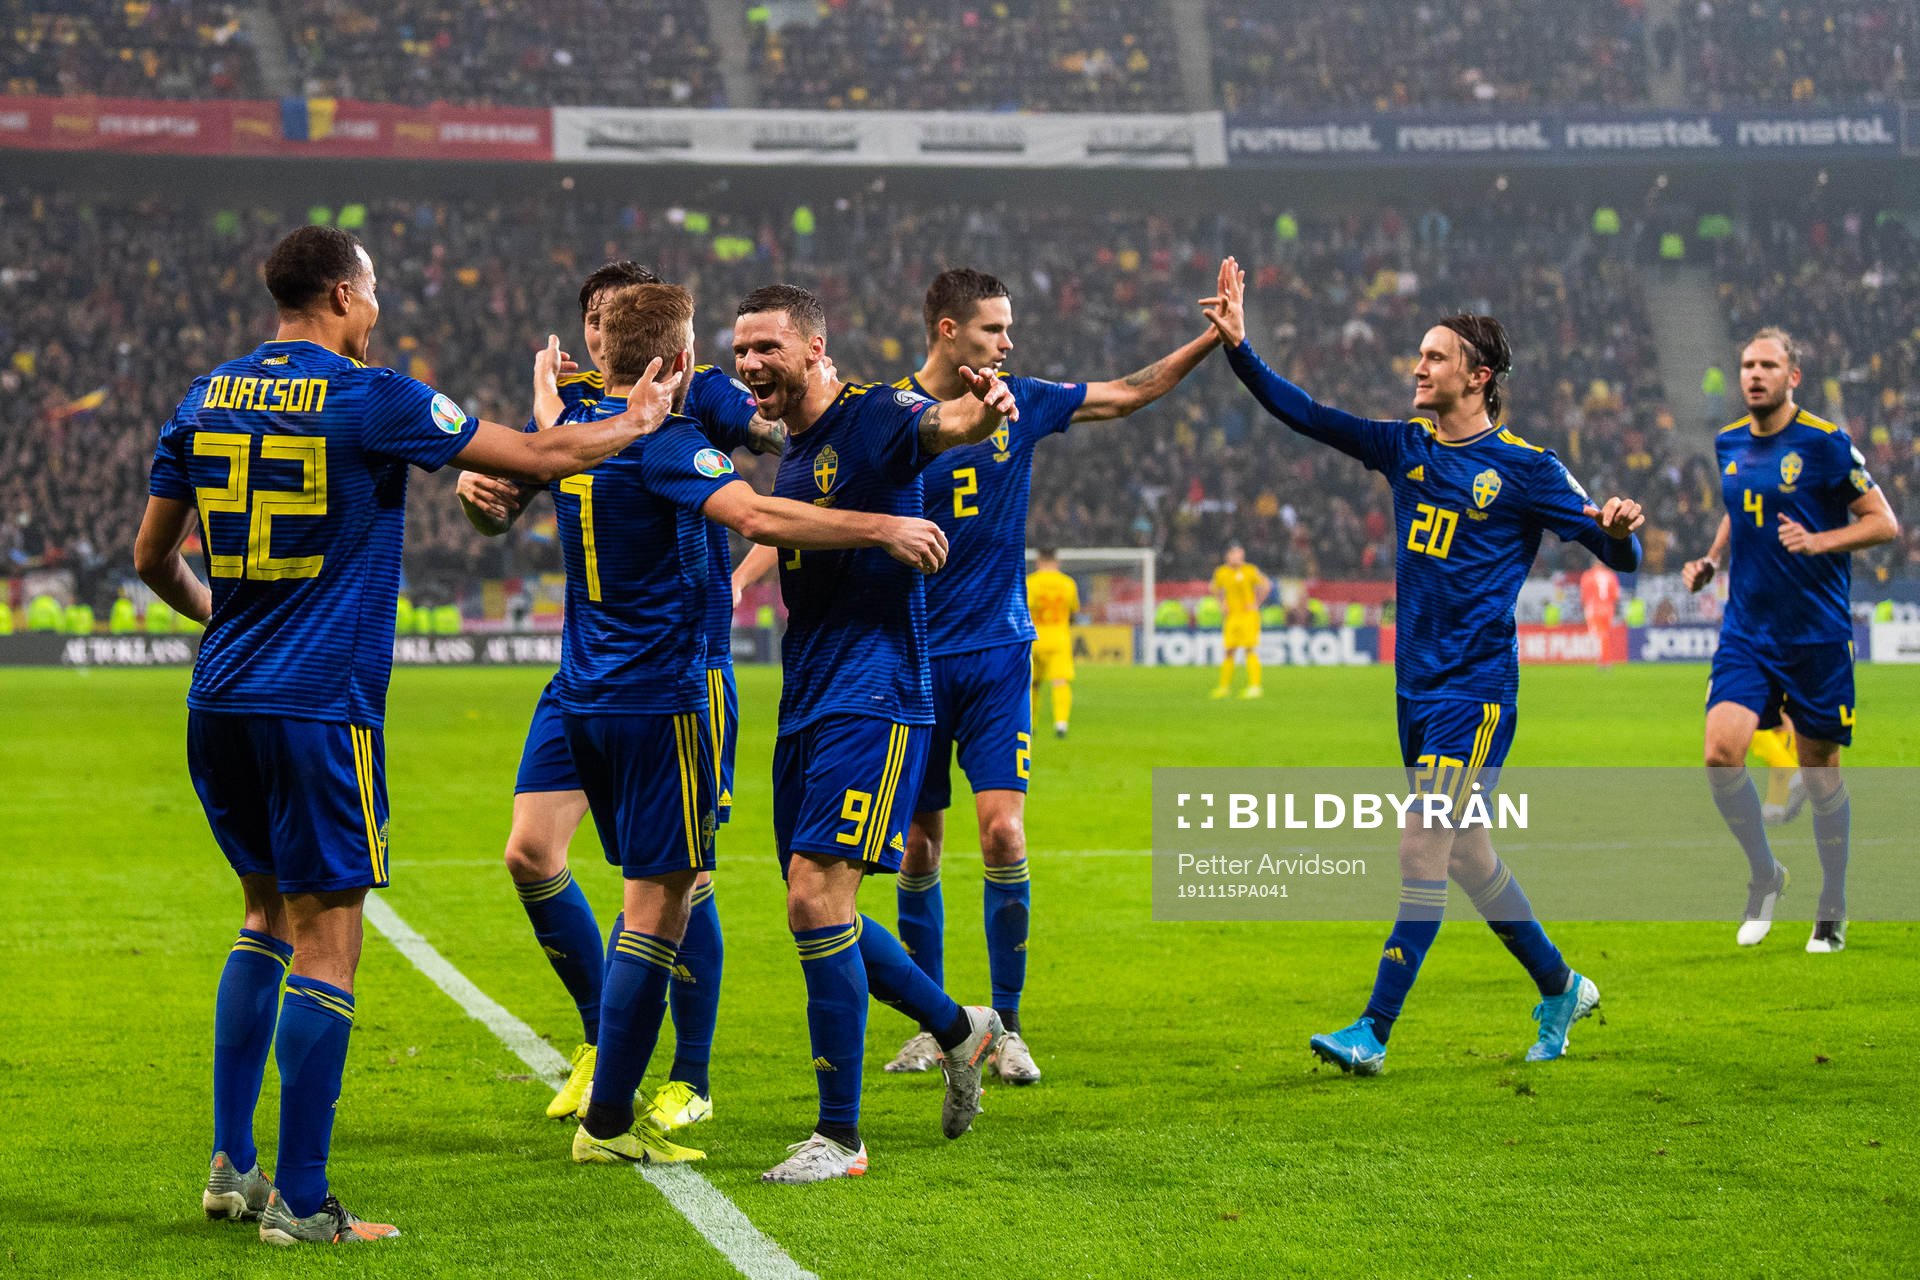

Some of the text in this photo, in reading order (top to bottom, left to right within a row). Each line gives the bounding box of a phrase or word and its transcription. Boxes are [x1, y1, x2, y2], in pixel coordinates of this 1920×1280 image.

[203, 375, 328, 412] QUAISON
[193, 432, 327, 581] 22
[952, 467, 979, 518] 2
[1743, 489, 1763, 527] 4
[1407, 503, 1459, 559] 20
[1016, 732, 1031, 779] 2
[1413, 754, 1464, 803] 20
[836, 789, 872, 846] 9
